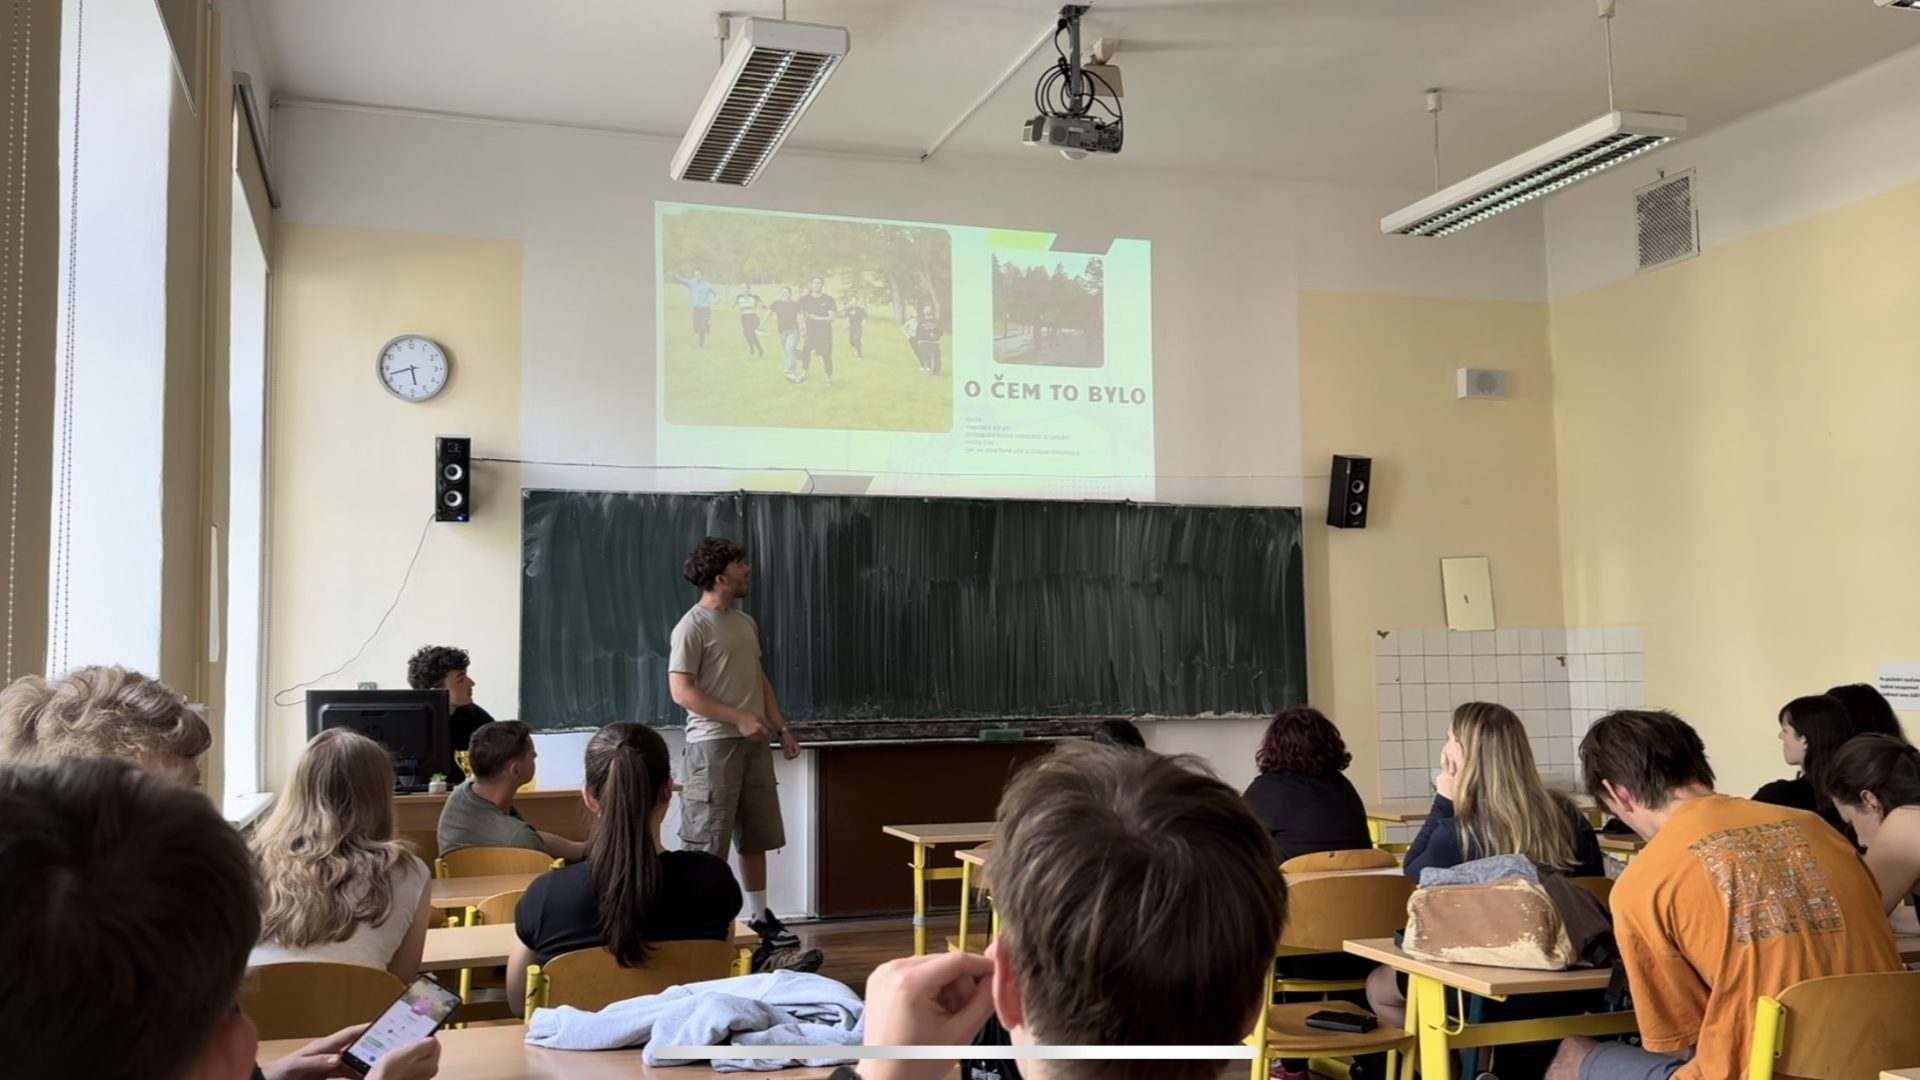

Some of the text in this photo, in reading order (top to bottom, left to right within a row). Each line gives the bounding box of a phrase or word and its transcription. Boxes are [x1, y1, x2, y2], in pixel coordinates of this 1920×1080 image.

[964, 374, 1146, 405] O ČEM TO BYLO
